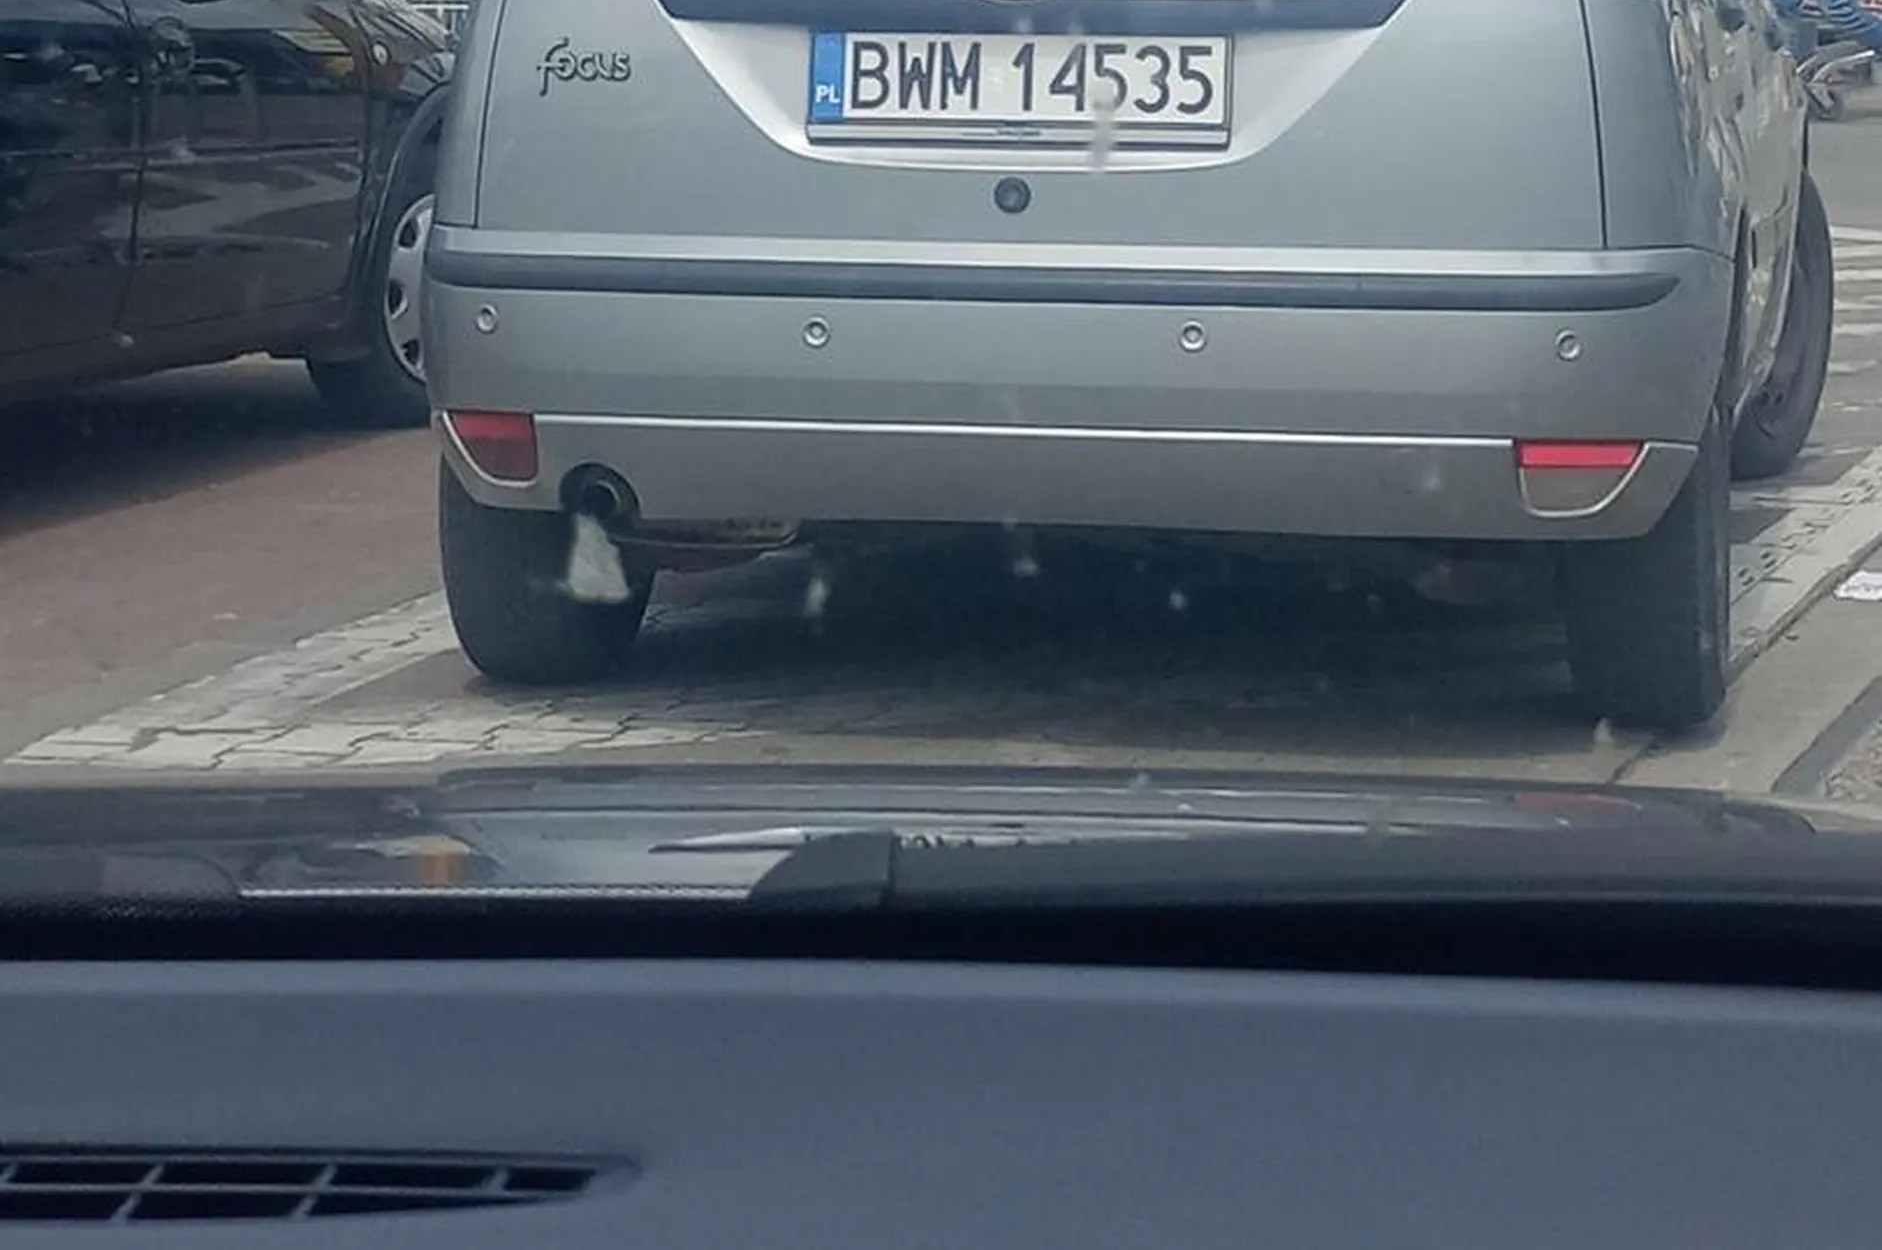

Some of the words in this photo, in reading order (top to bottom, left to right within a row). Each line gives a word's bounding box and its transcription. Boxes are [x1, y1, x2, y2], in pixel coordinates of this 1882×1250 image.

[815, 84, 841, 103] PL
[851, 40, 983, 111] BWM
[1012, 41, 1214, 115] 14535
